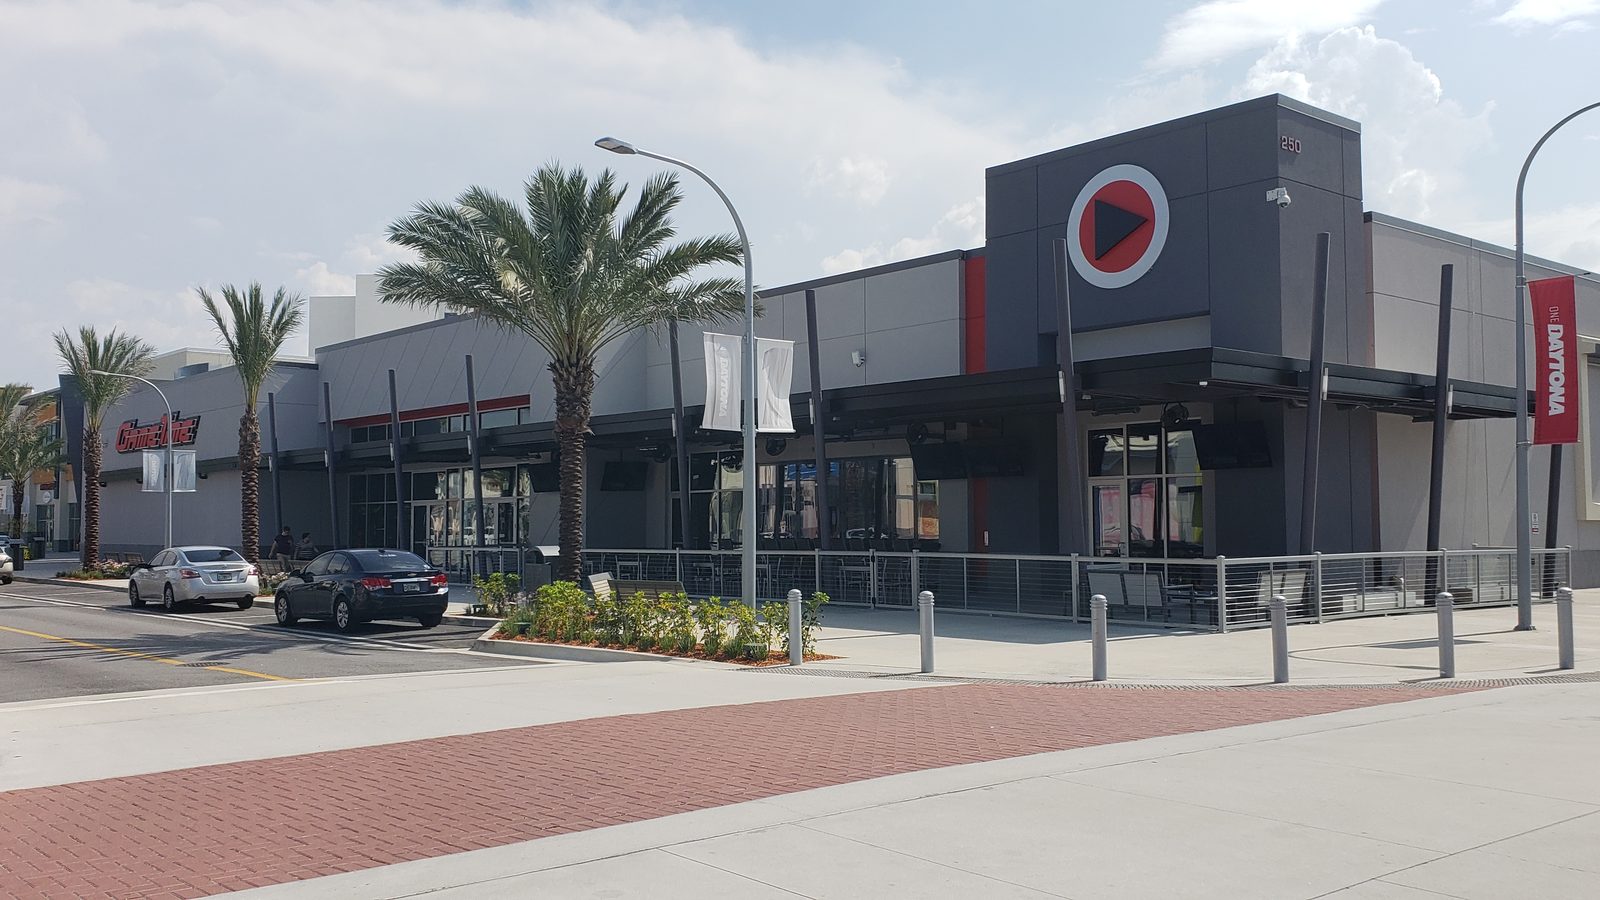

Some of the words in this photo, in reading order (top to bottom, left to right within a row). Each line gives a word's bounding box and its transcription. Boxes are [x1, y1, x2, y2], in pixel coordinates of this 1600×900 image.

[1281, 136, 1301, 153] 250
[1549, 306, 1559, 323] ONE
[1548, 323, 1565, 416] DAYTONA
